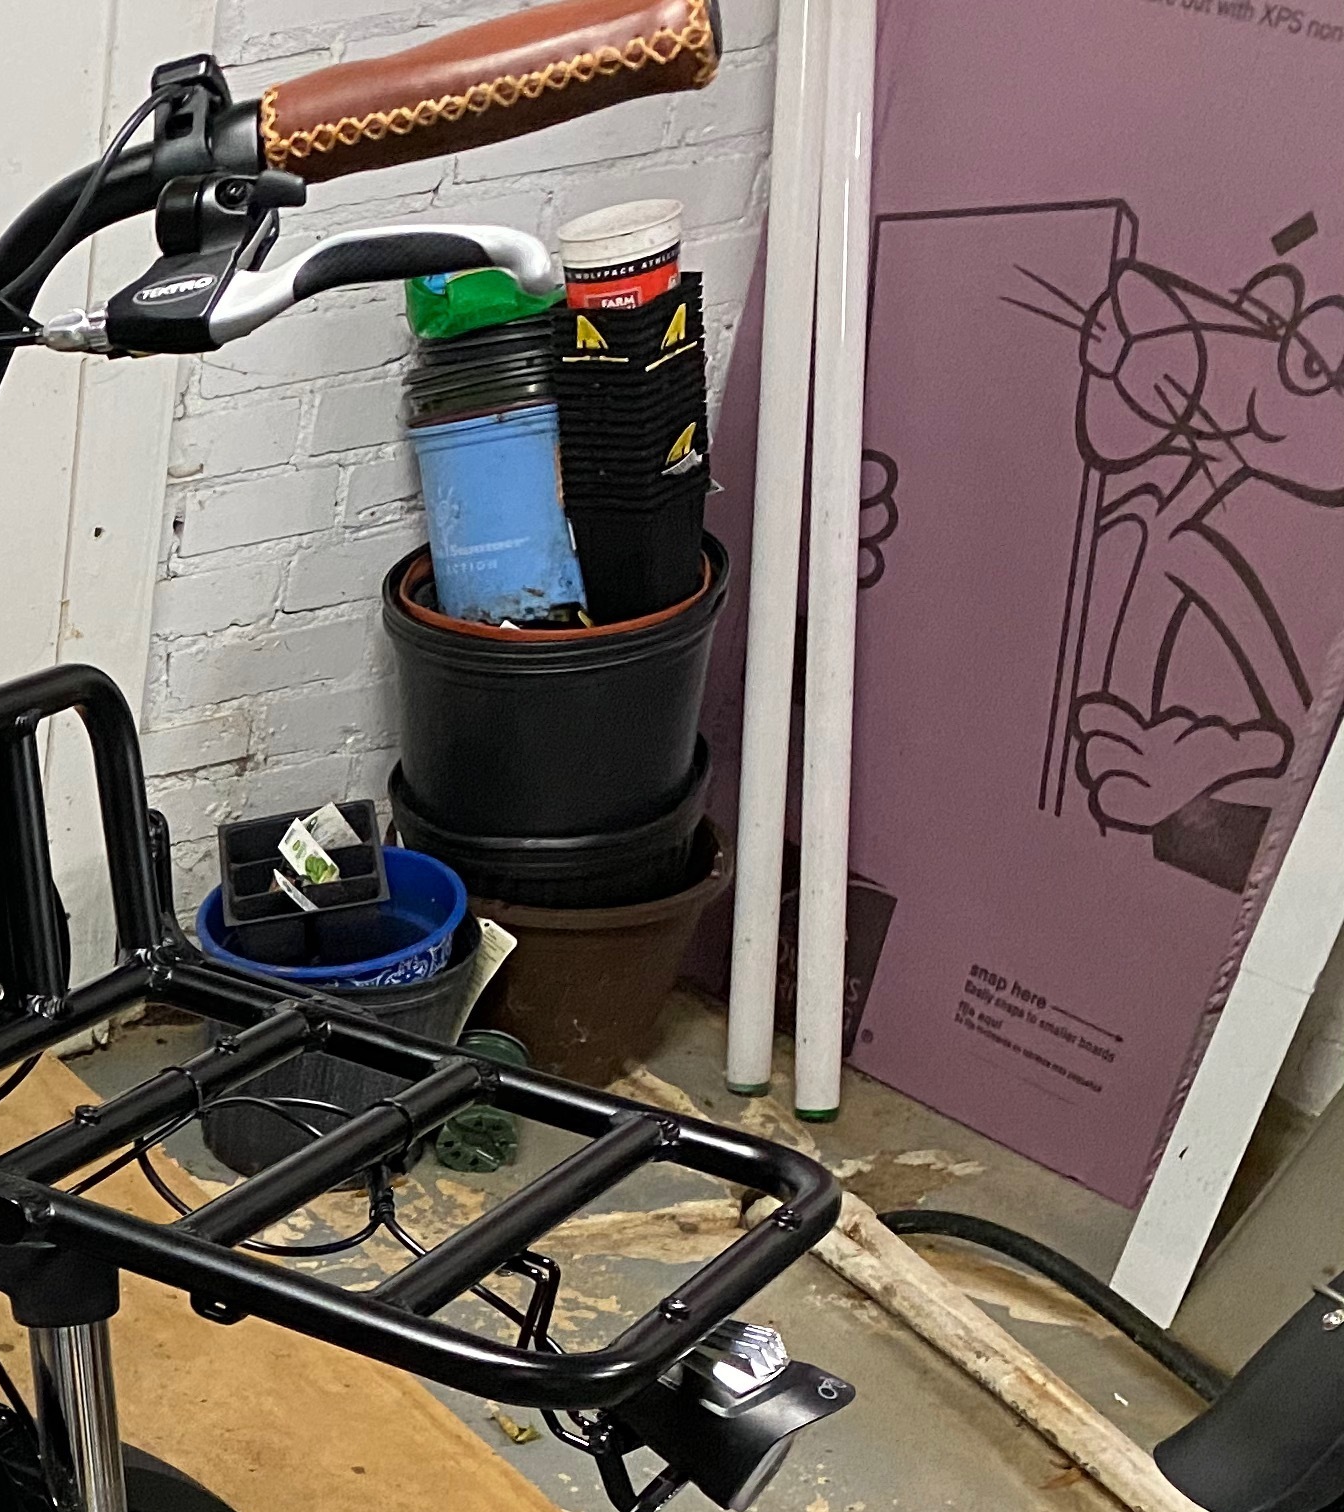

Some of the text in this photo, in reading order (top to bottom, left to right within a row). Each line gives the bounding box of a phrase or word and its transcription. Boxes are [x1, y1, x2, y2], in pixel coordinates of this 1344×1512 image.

[1258, 2, 1304, 34] XPS
[575, 264, 635, 280] WOLFPACK
[141, 276, 213, 300] TEKTRO
[601, 294, 636, 308] FARM
[969, 964, 1047, 1009] snap here
[1026, 1011, 1037, 1024] to
[1039, 1019, 1077, 1043] smaller
